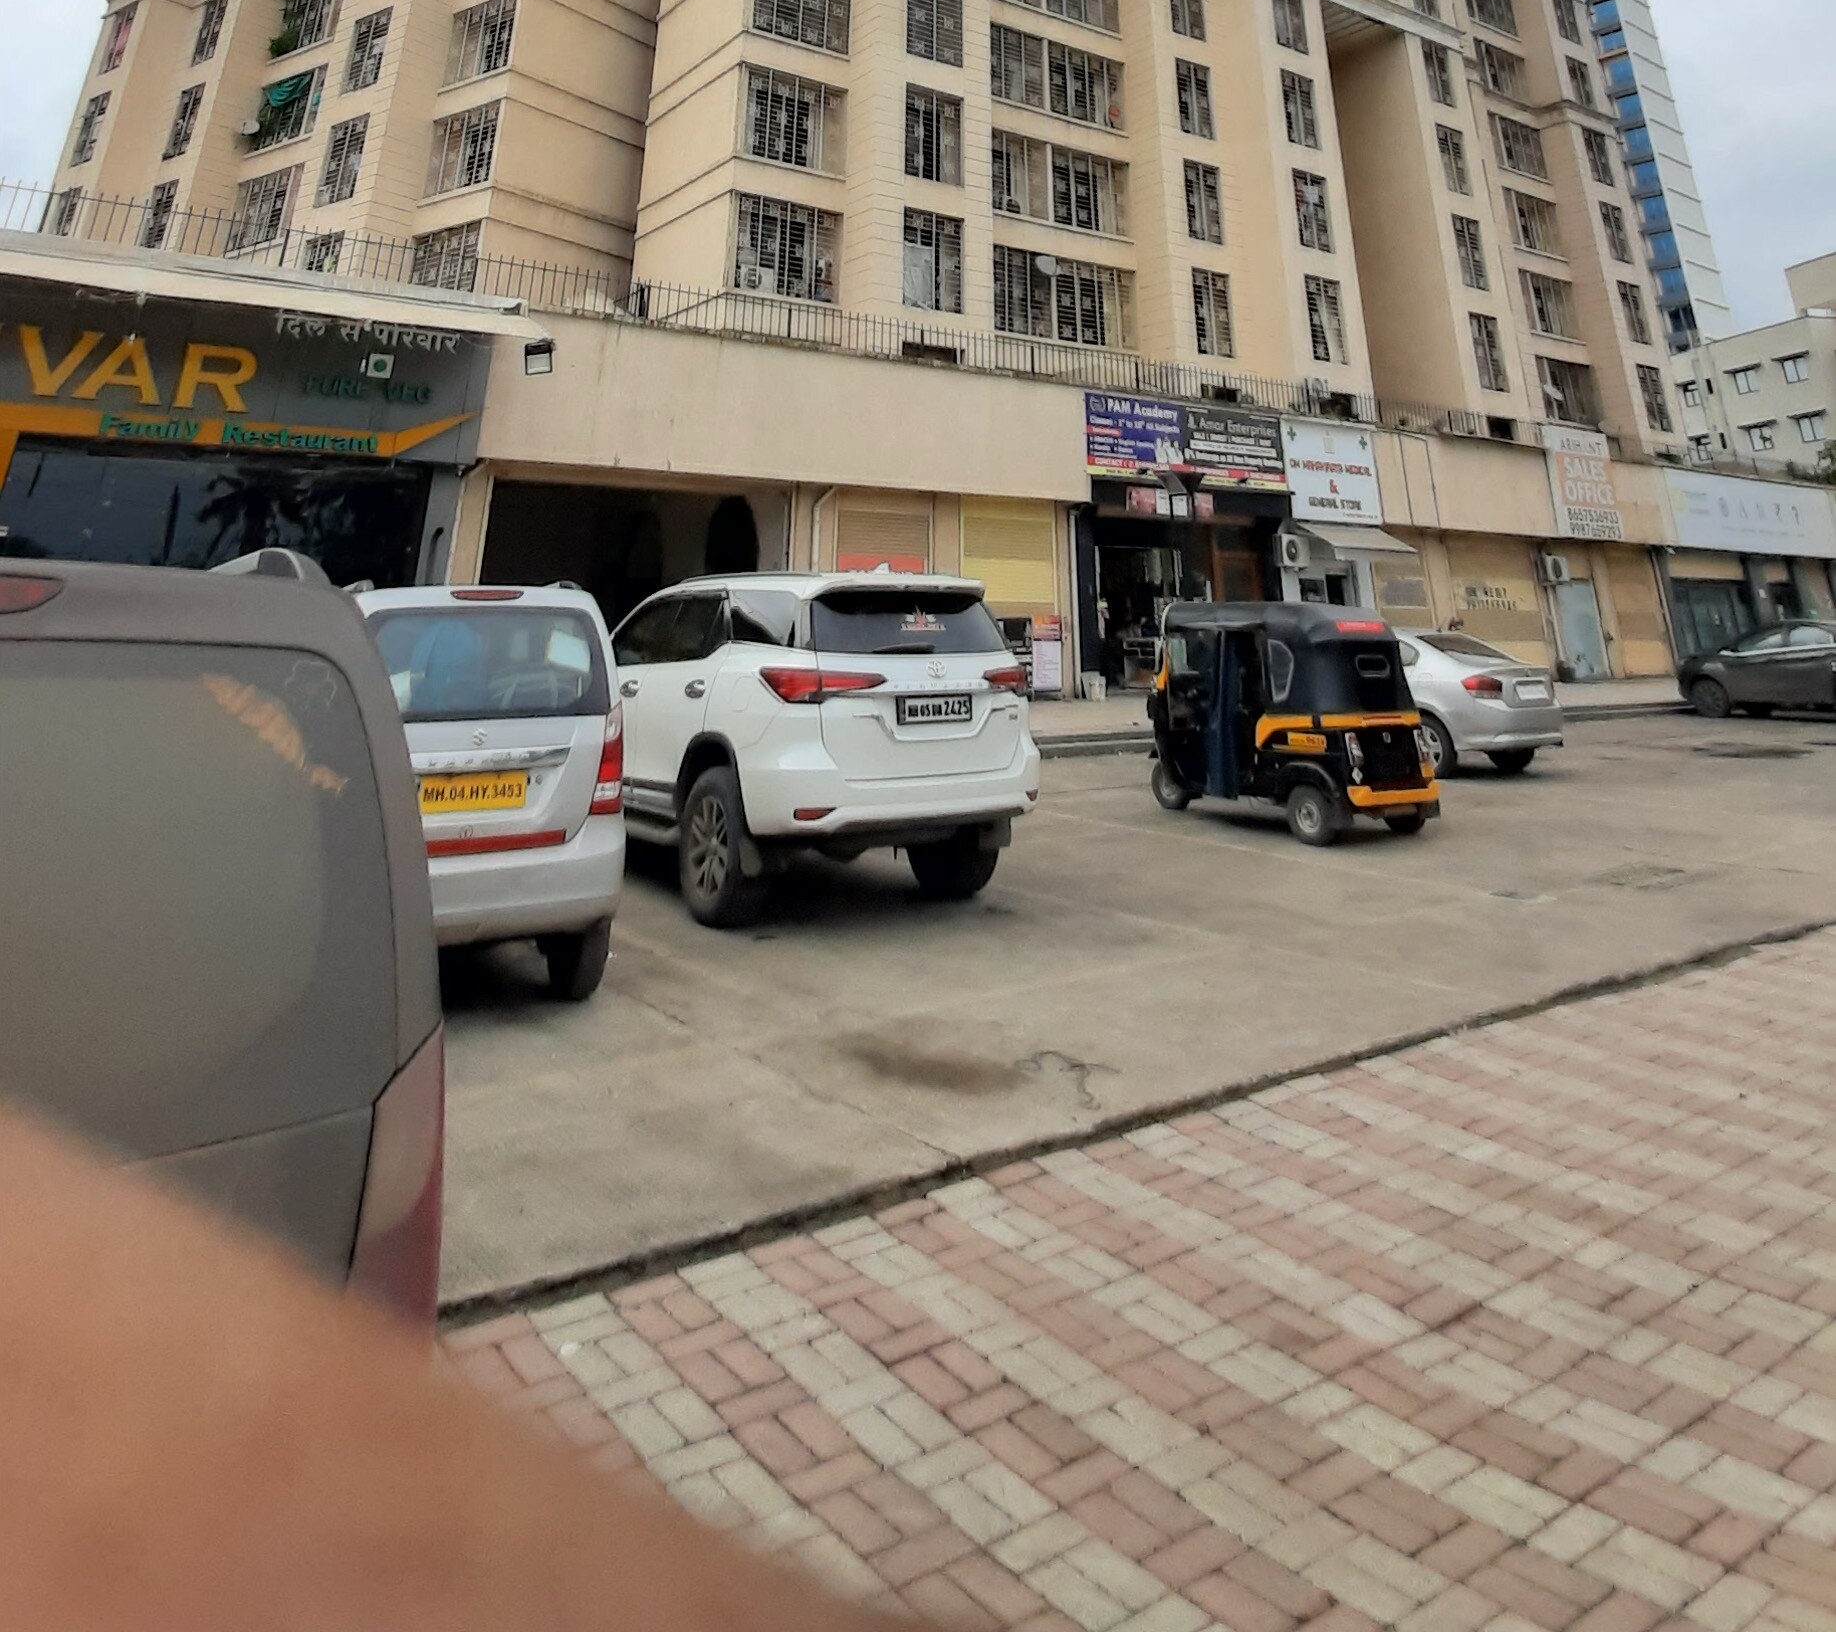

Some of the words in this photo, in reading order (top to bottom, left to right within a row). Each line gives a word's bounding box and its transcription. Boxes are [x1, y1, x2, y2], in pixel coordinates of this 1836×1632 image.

[0, 323, 258, 413] VAR
[1107, 397, 1132, 415] PAM
[1134, 402, 1178, 423] Academy
[100, 414, 199, 440] Family
[222, 421, 379, 454] Restaurant
[1226, 419, 1278, 440] Enterprises
[1563, 456, 1607, 483] SALES
[1329, 479, 1340, 495] &
[1564, 479, 1616, 506] OFFICE
[943, 700, 970, 716] 2425
